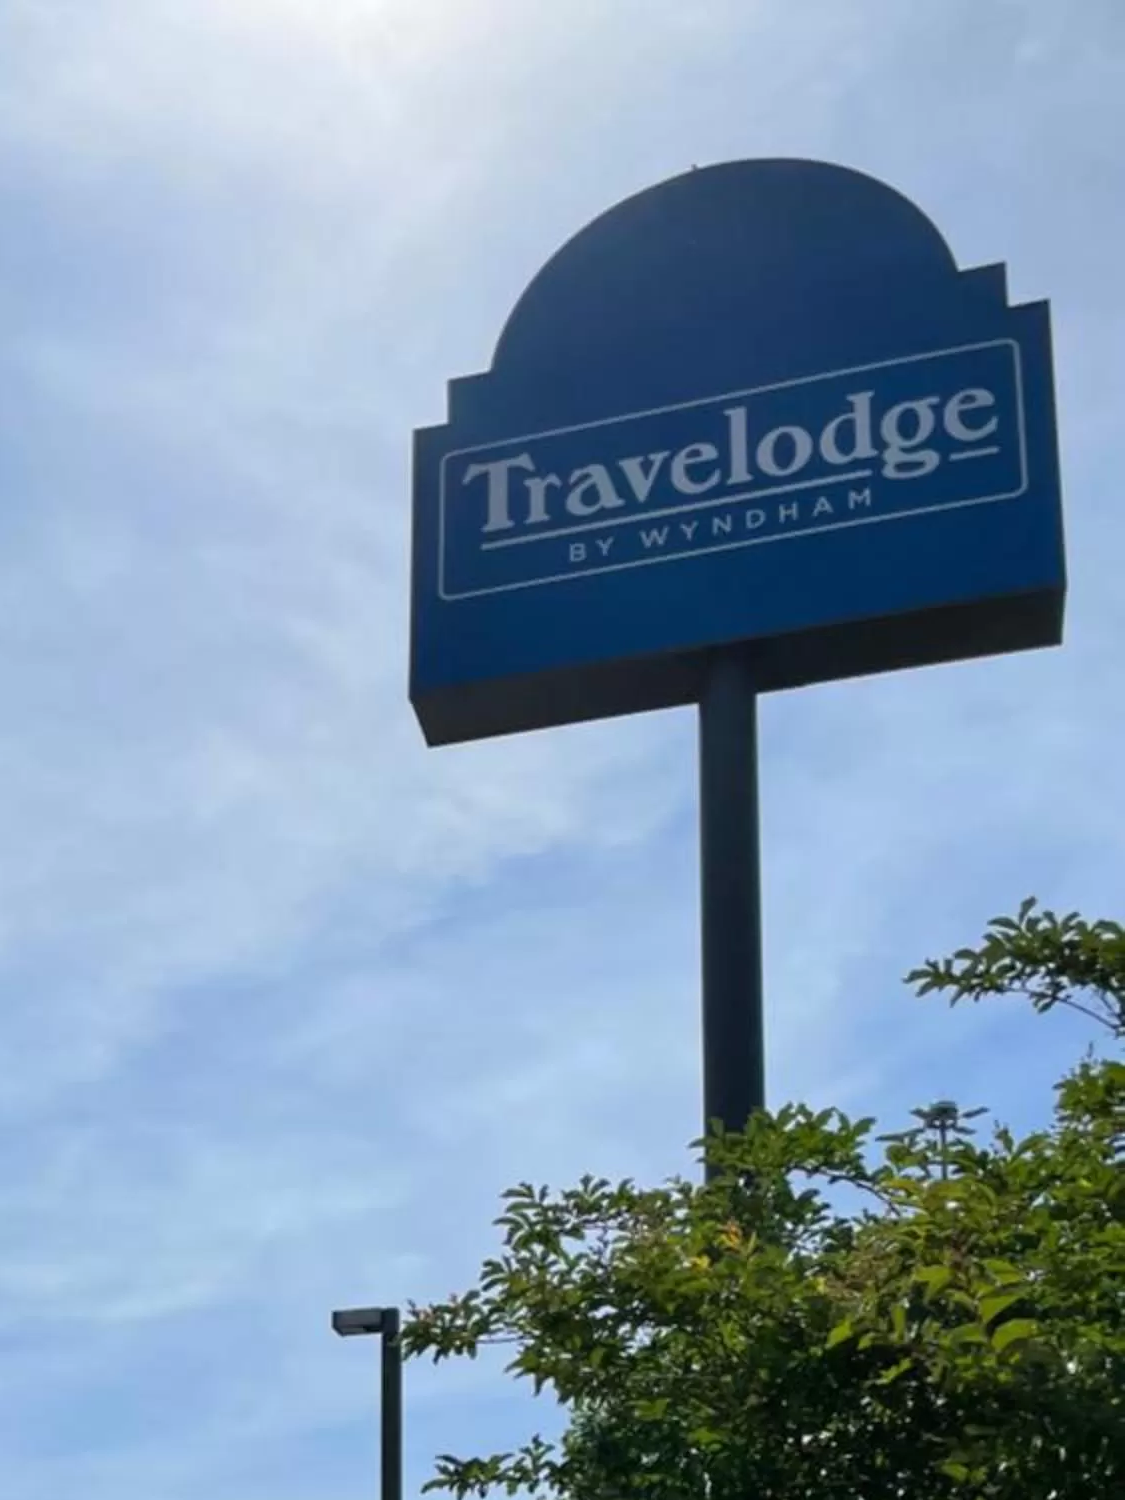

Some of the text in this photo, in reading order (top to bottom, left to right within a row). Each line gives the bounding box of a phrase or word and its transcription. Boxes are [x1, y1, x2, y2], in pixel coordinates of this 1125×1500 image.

[461, 386, 1000, 533] Travelodge
[569, 487, 873, 563] BY WYNDHAM
